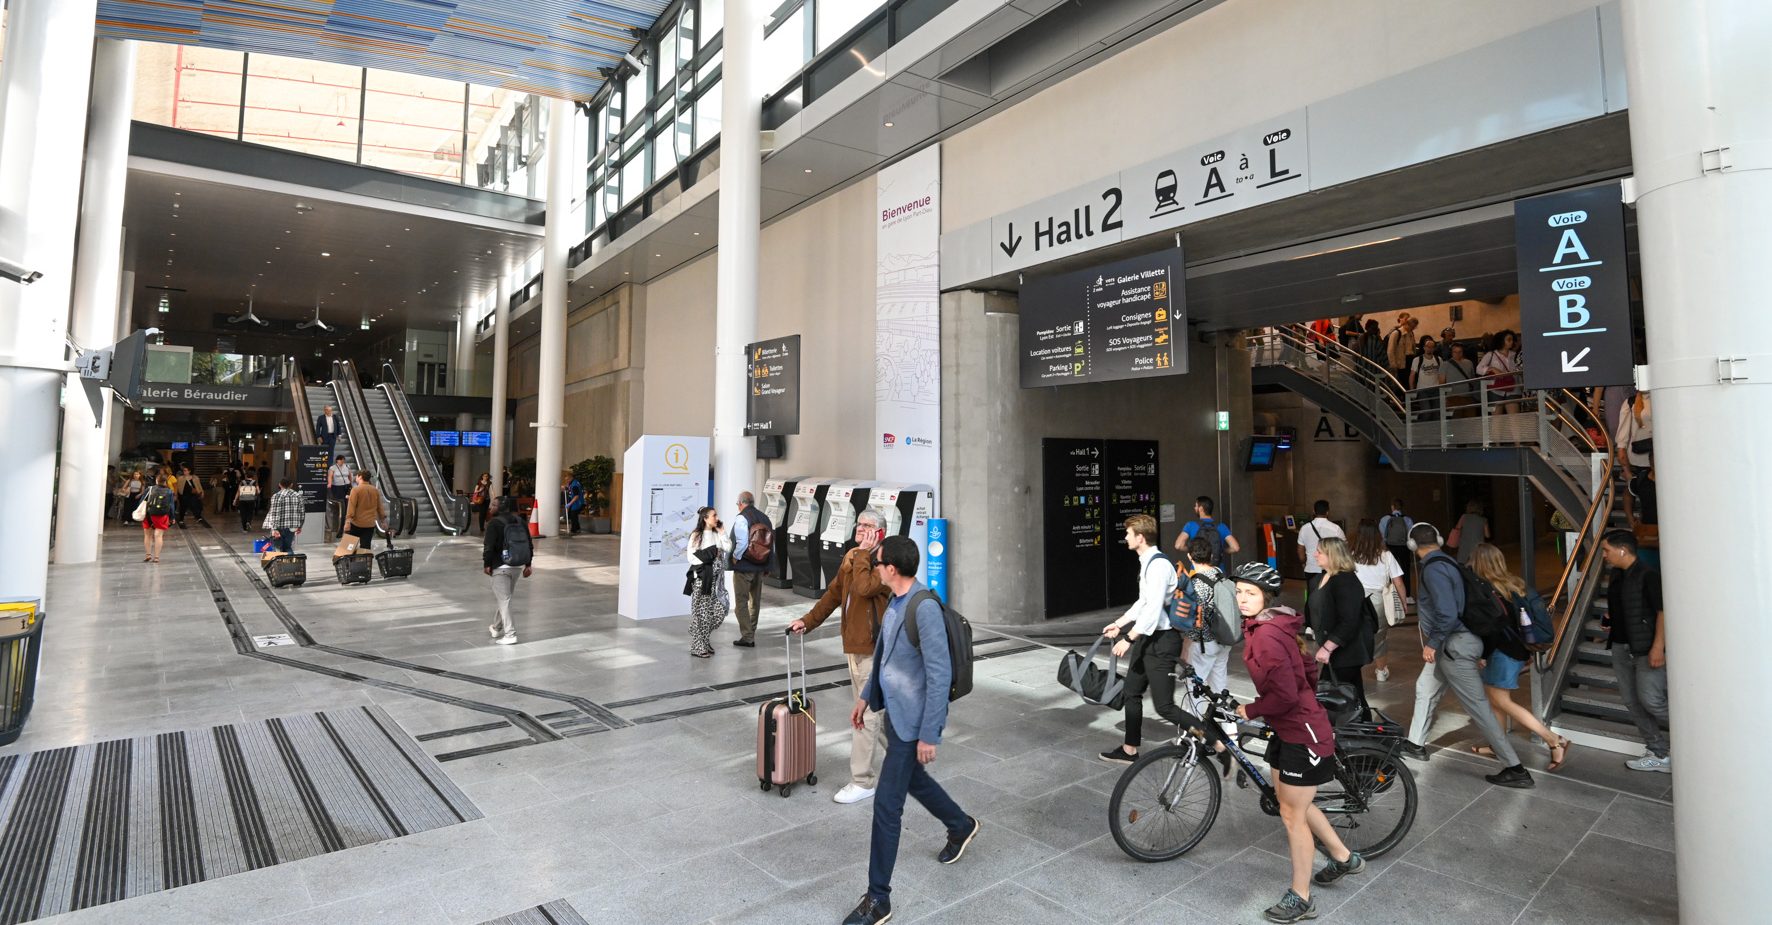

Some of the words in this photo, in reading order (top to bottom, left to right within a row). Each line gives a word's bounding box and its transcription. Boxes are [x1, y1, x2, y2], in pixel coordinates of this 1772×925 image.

[1265, 130, 1288, 145] Voie
[1202, 151, 1223, 165] Voie
[1239, 153, 1250, 171] à
[1269, 148, 1290, 179] L
[1202, 166, 1226, 199] A
[882, 196, 931, 222] Bienvenue
[1034, 204, 1095, 252] Hall
[1101, 187, 1124, 233] 2
[1552, 213, 1582, 226] Voie
[1552, 228, 1590, 264] A
[1117, 273, 1139, 284] Galerie
[1140, 268, 1165, 279] Villette
[1121, 285, 1151, 296] Assistance
[1556, 278, 1586, 290] Voie
[1096, 298, 1121, 309] voyageur
[1122, 292, 1152, 304] handicapé
[1121, 312, 1152, 322] Consignes
[1558, 293, 1591, 329] B
[1056, 325, 1071, 333] Sortie
[1108, 337, 1121, 346] SOS
[1121, 334, 1153, 345] Voyageurs
[1030, 348, 1051, 357] Location
[1051, 345, 1072, 354] voitures
[1049, 363, 1068, 372] Parking
[1068, 362, 1073, 370] 3
[1134, 356, 1154, 365] Police
[142, 387, 179, 398] alerie
[184, 388, 248, 401] Béraudier
[1075, 448, 1086, 456] Hall
[1075, 464, 1089, 472] Sortie
[1282, 769, 1303, 778] hummel
